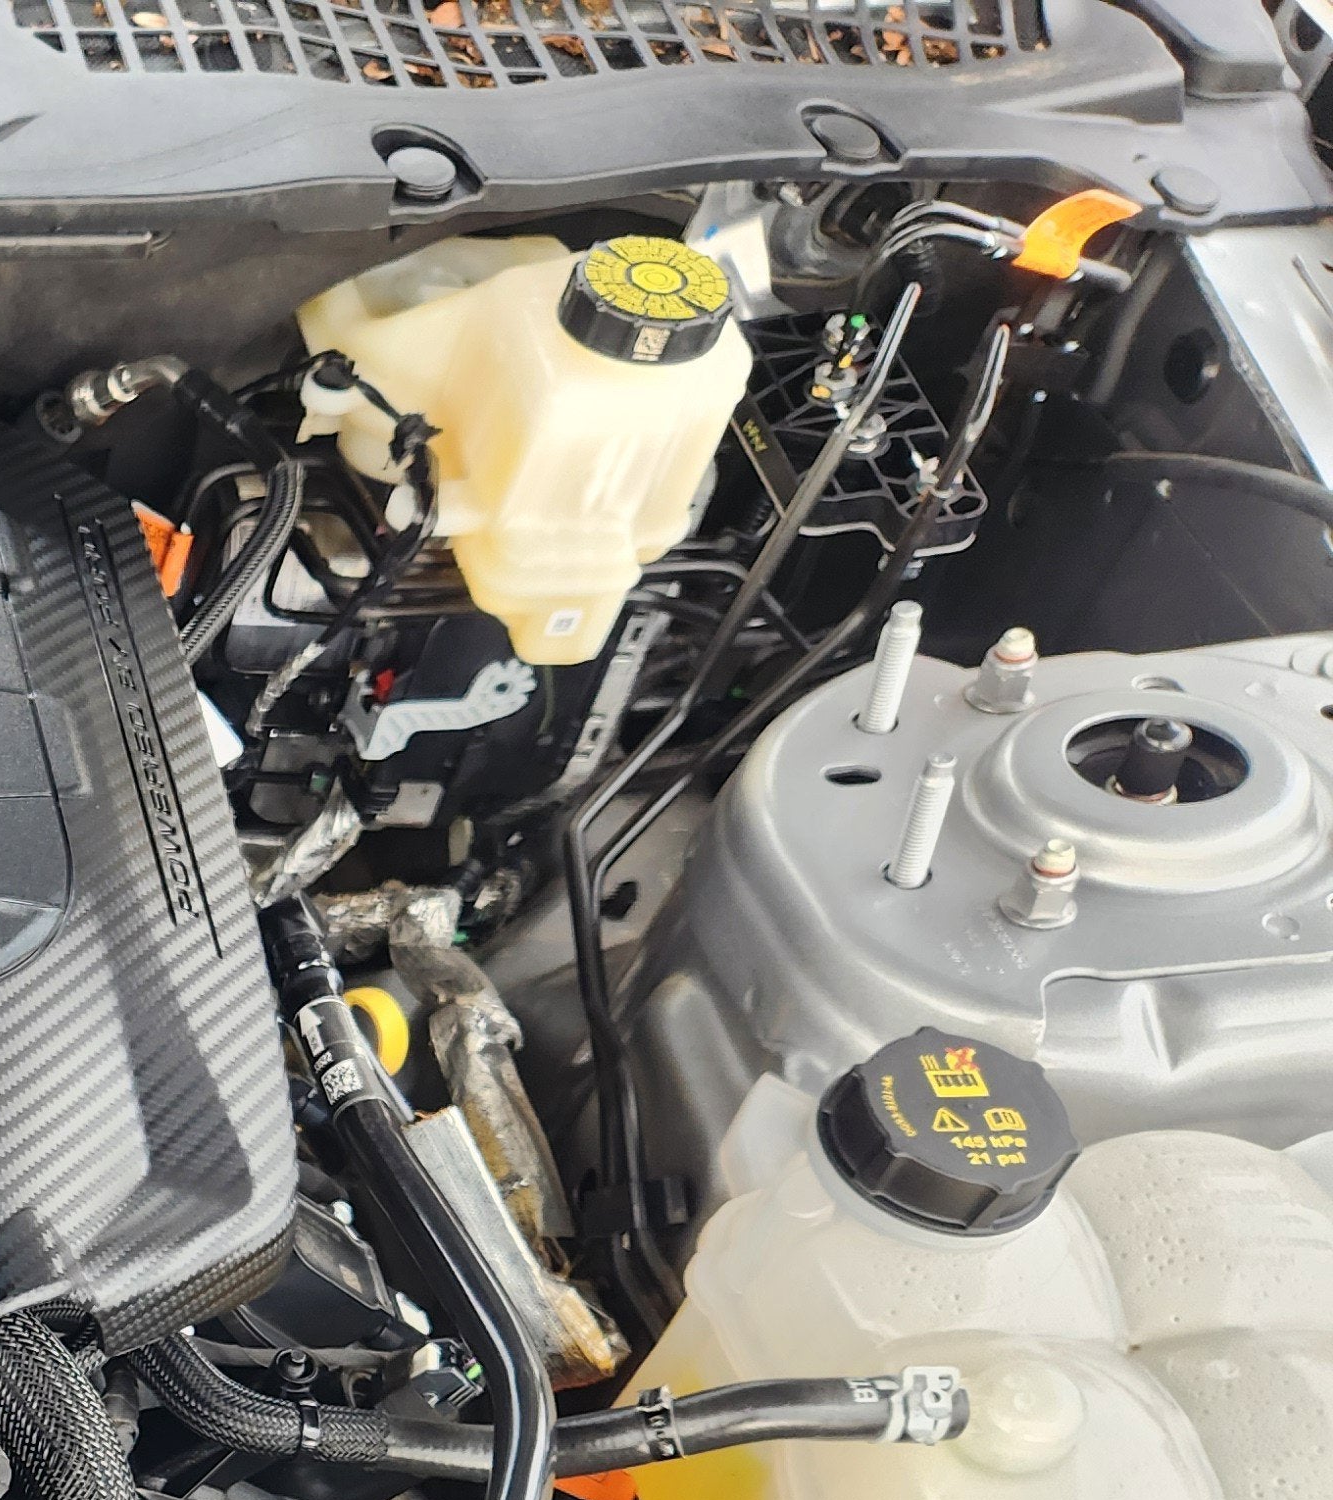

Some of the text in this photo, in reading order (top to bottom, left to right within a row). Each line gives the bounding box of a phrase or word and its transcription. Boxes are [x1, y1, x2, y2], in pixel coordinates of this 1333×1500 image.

[126, 702, 200, 919] POWERED
[989, 1135, 1027, 1149] kPa
[966, 1152, 1027, 1168] 21 psi
